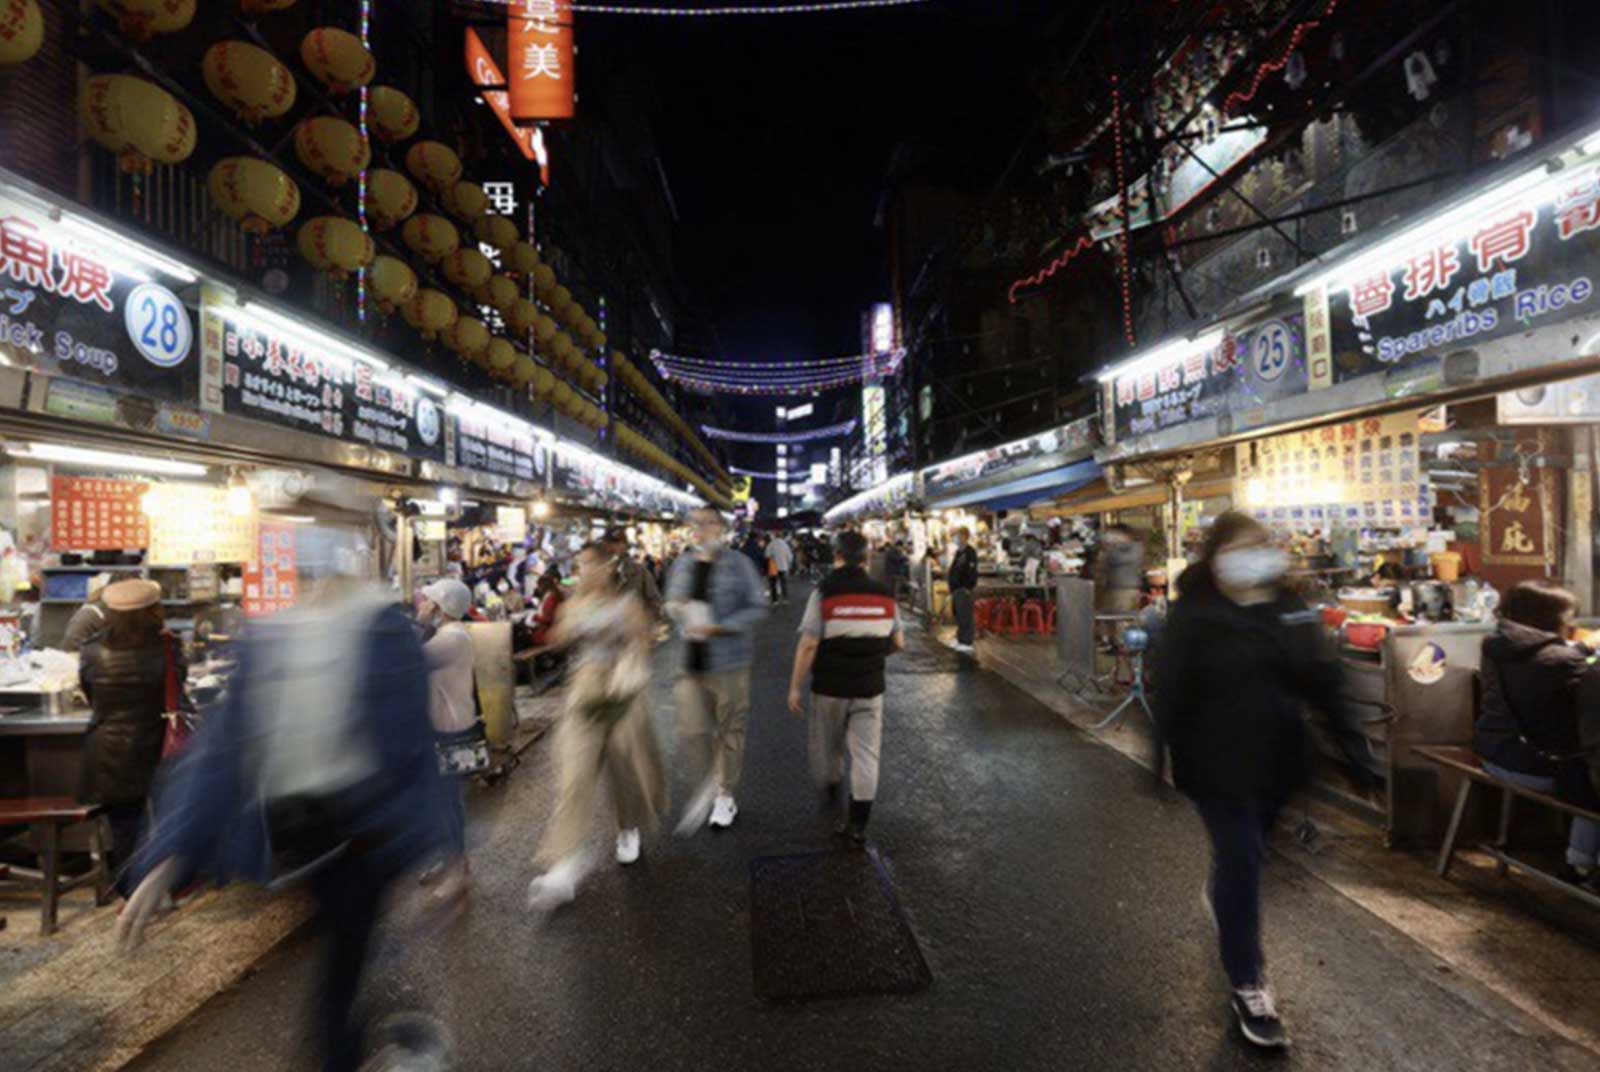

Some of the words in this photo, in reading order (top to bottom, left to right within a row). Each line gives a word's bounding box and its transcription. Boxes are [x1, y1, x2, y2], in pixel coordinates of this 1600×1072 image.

[140, 296, 179, 354] 28
[1377, 307, 1498, 362] Spareribs
[1515, 277, 1592, 320] Rice
[55, 330, 119, 376] Soup
[1259, 328, 1284, 373] 25
